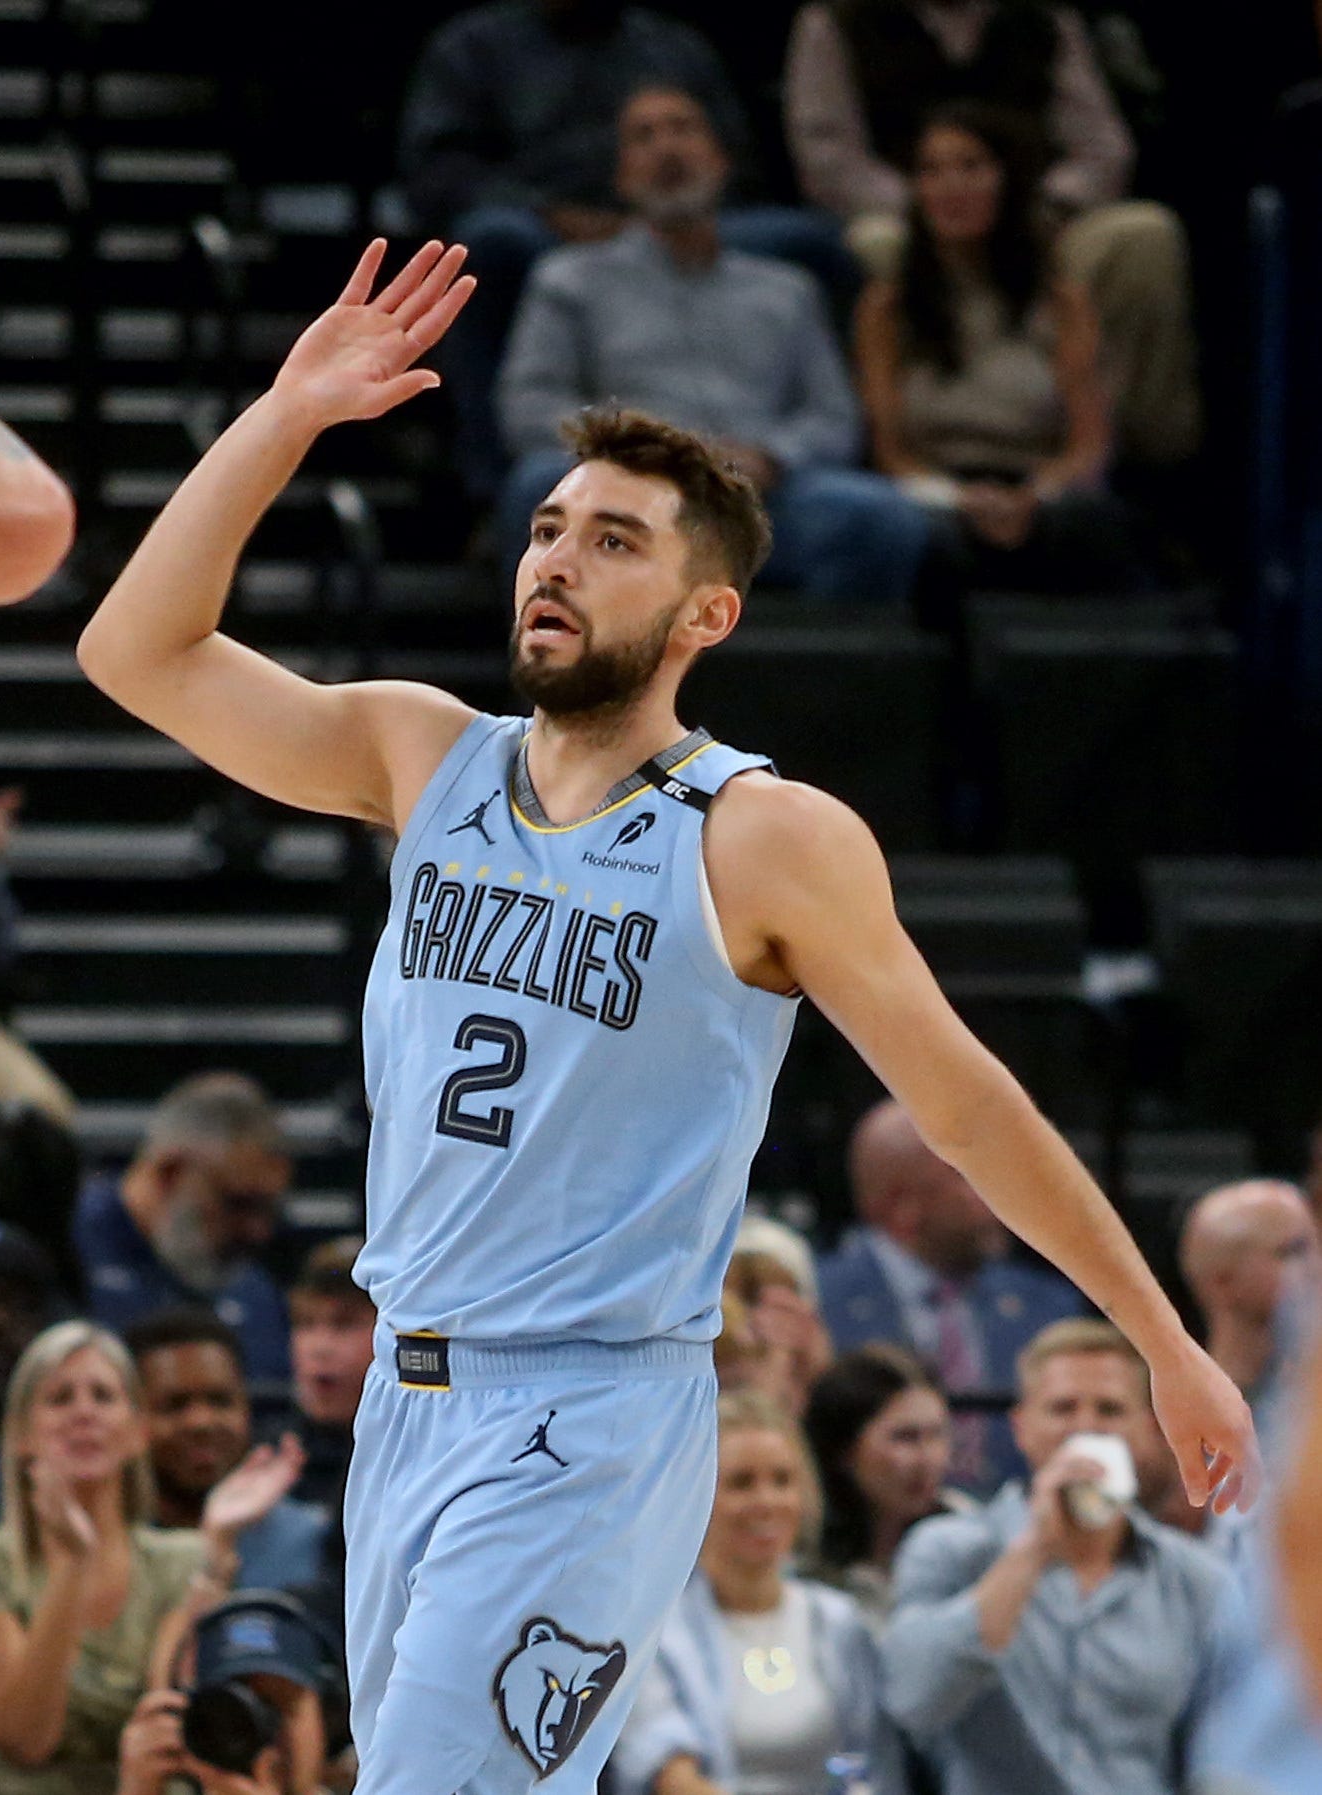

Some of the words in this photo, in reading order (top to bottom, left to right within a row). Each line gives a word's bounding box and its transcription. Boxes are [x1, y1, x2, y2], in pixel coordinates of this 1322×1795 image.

[662, 780, 690, 800] BC
[582, 851, 661, 875] Robinhood
[400, 861, 658, 1031] GRIZZLIES
[436, 1013, 527, 1149] 2
